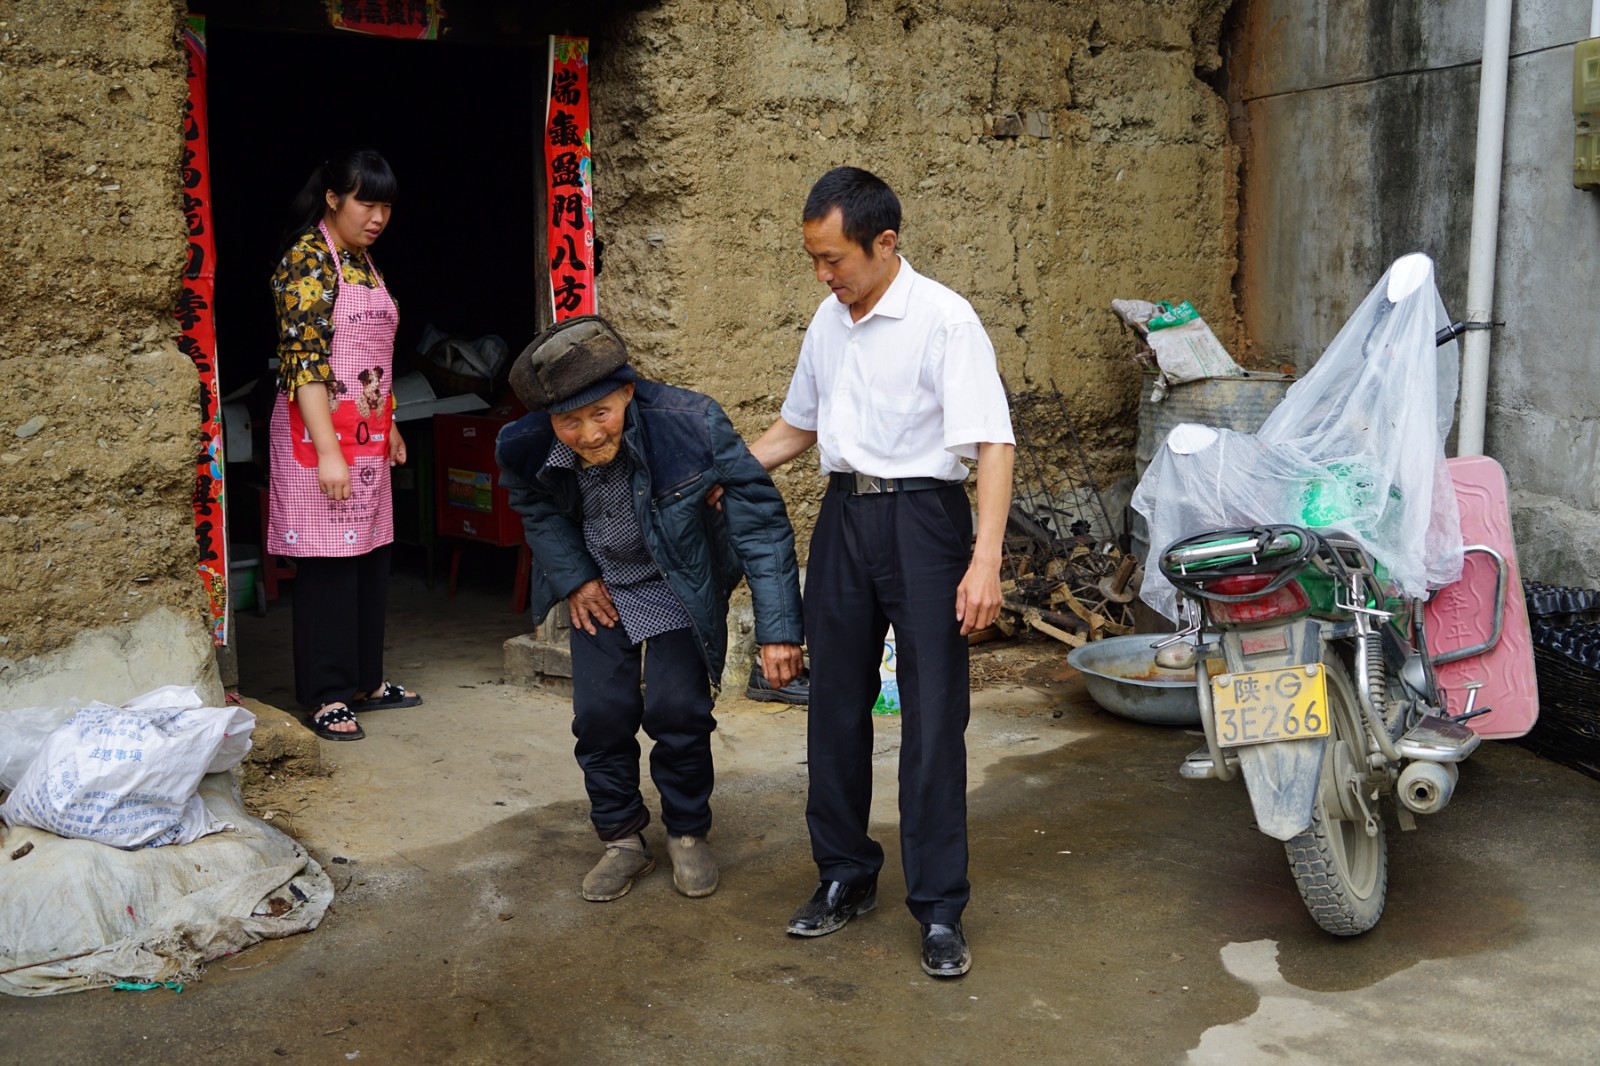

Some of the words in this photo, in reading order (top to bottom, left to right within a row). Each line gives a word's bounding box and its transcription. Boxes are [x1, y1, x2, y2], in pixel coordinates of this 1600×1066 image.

[549, 68, 586, 320] 瑞氣盈門八方
[1221, 700, 1321, 741] 3E266
